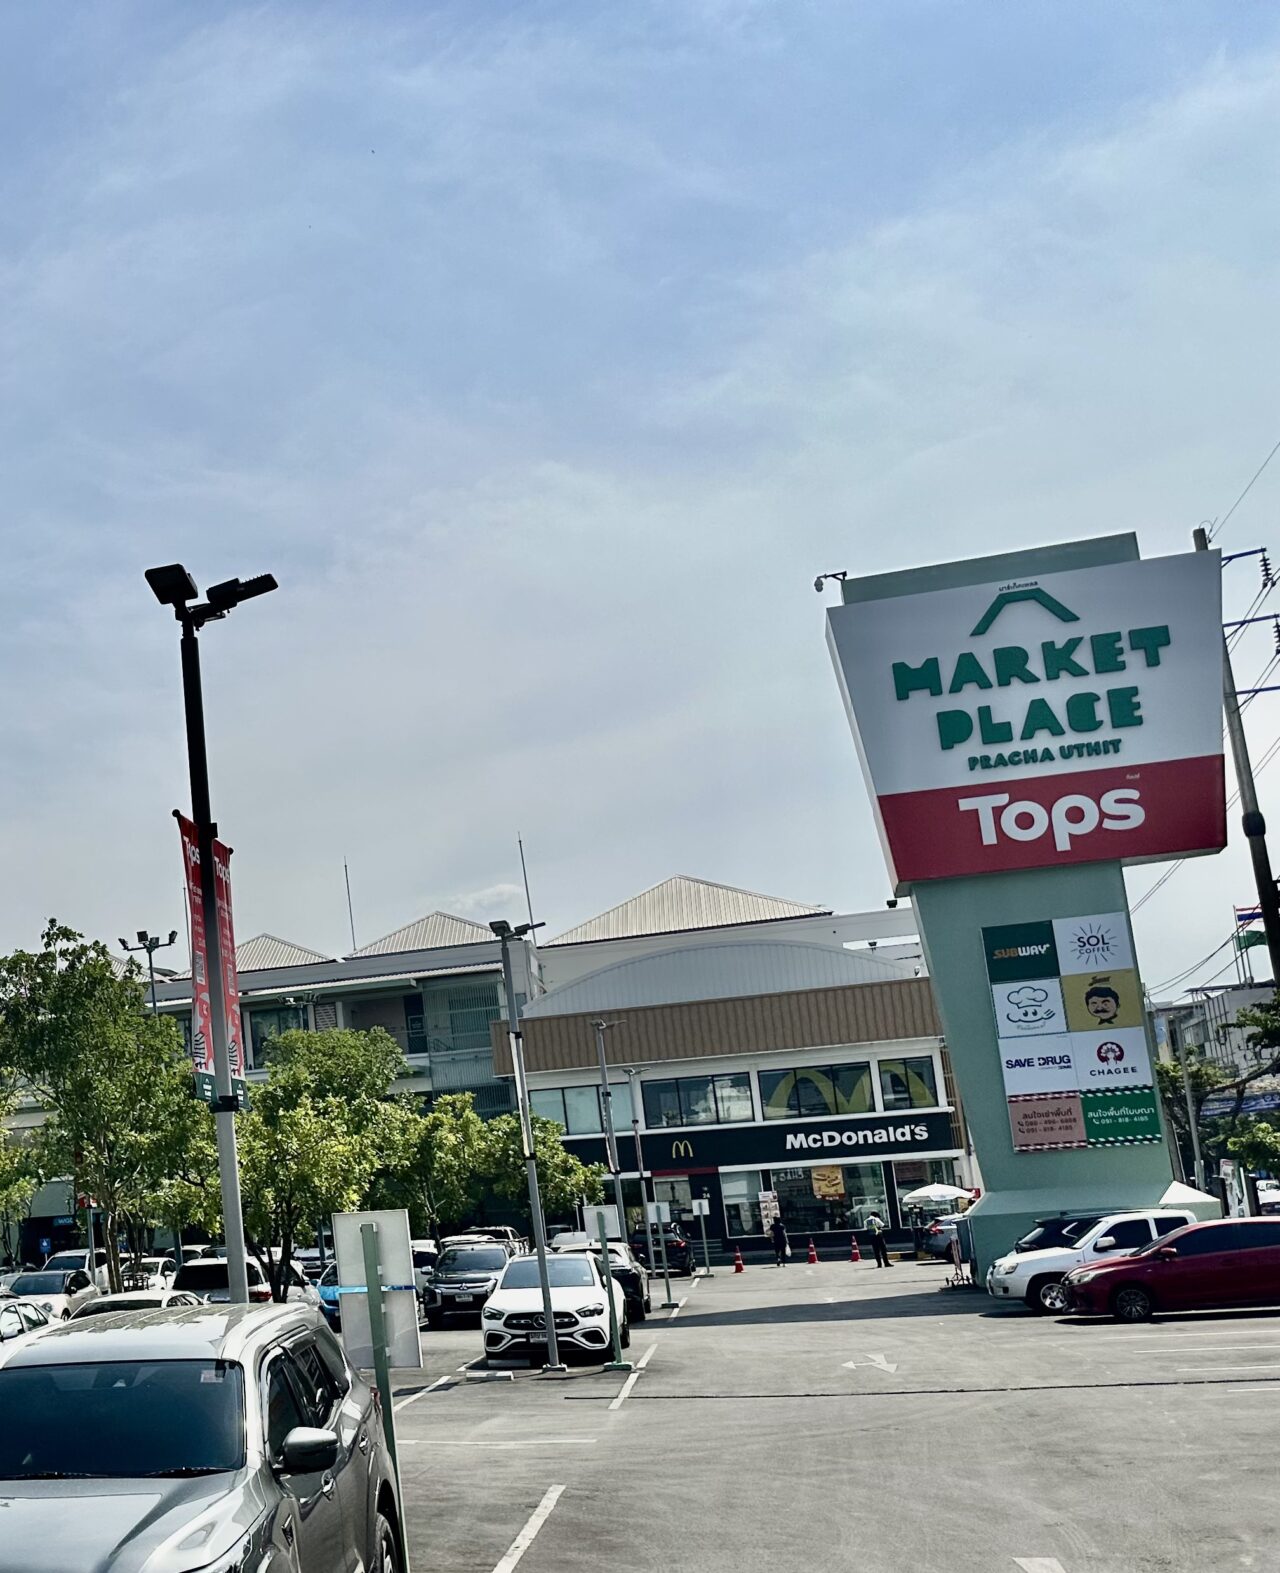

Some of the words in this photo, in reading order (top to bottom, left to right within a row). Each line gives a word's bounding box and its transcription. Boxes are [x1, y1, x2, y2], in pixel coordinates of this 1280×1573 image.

[892, 625, 1171, 701] MARKET
[936, 686, 1143, 750] PLACE
[968, 747, 1055, 771] PRACHA
[1060, 738, 1122, 760] UTHIT
[958, 788, 1145, 852] Tops
[993, 943, 1051, 959] SUBWAY
[1077, 934, 1110, 948] SOL
[1078, 946, 1111, 955] COFFEE
[1006, 1057, 1035, 1069] SAVE
[1038, 1054, 1071, 1067] DRUG
[1089, 1066, 1137, 1077] CHAGEE
[786, 1124, 929, 1149] McDonald's
